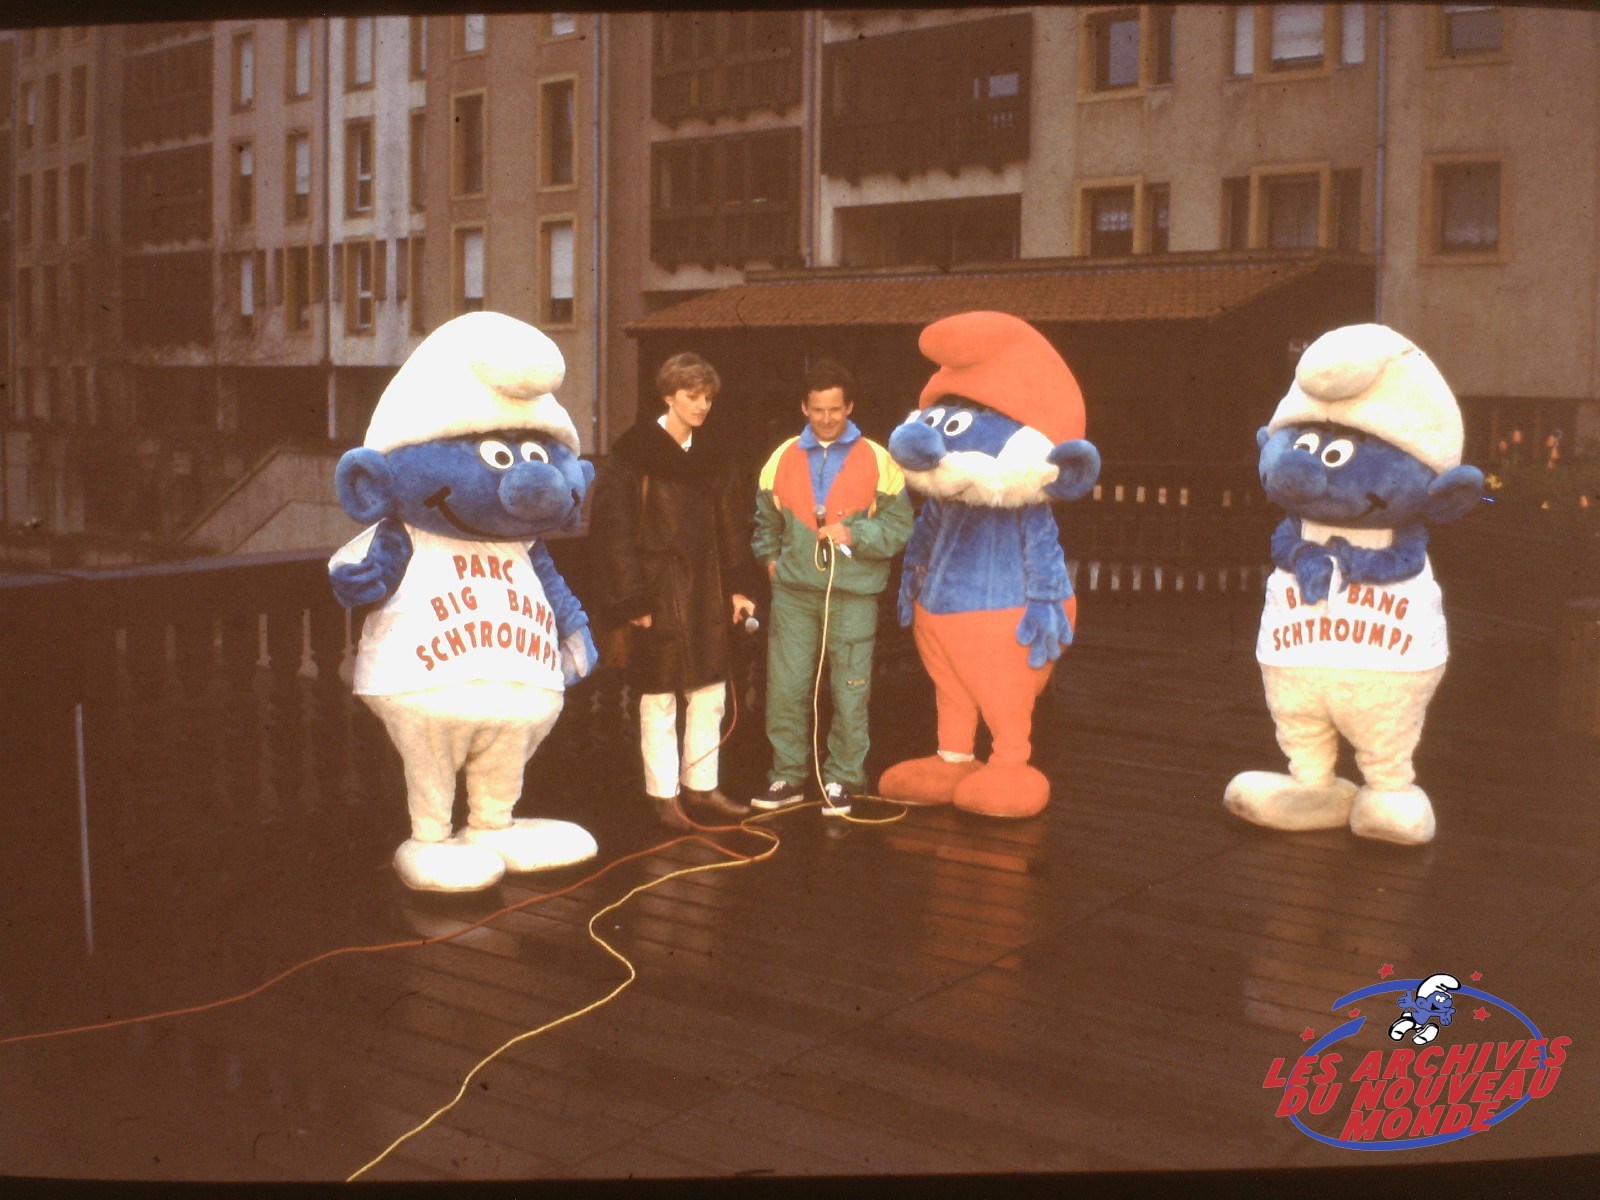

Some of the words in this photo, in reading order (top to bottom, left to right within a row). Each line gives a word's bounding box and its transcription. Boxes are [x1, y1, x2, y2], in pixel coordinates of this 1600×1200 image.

[453, 554, 514, 584] PARC
[430, 586, 478, 622] BIG
[1347, 583, 1409, 620] BANG
[1272, 617, 1413, 656] SCHTROUMPF
